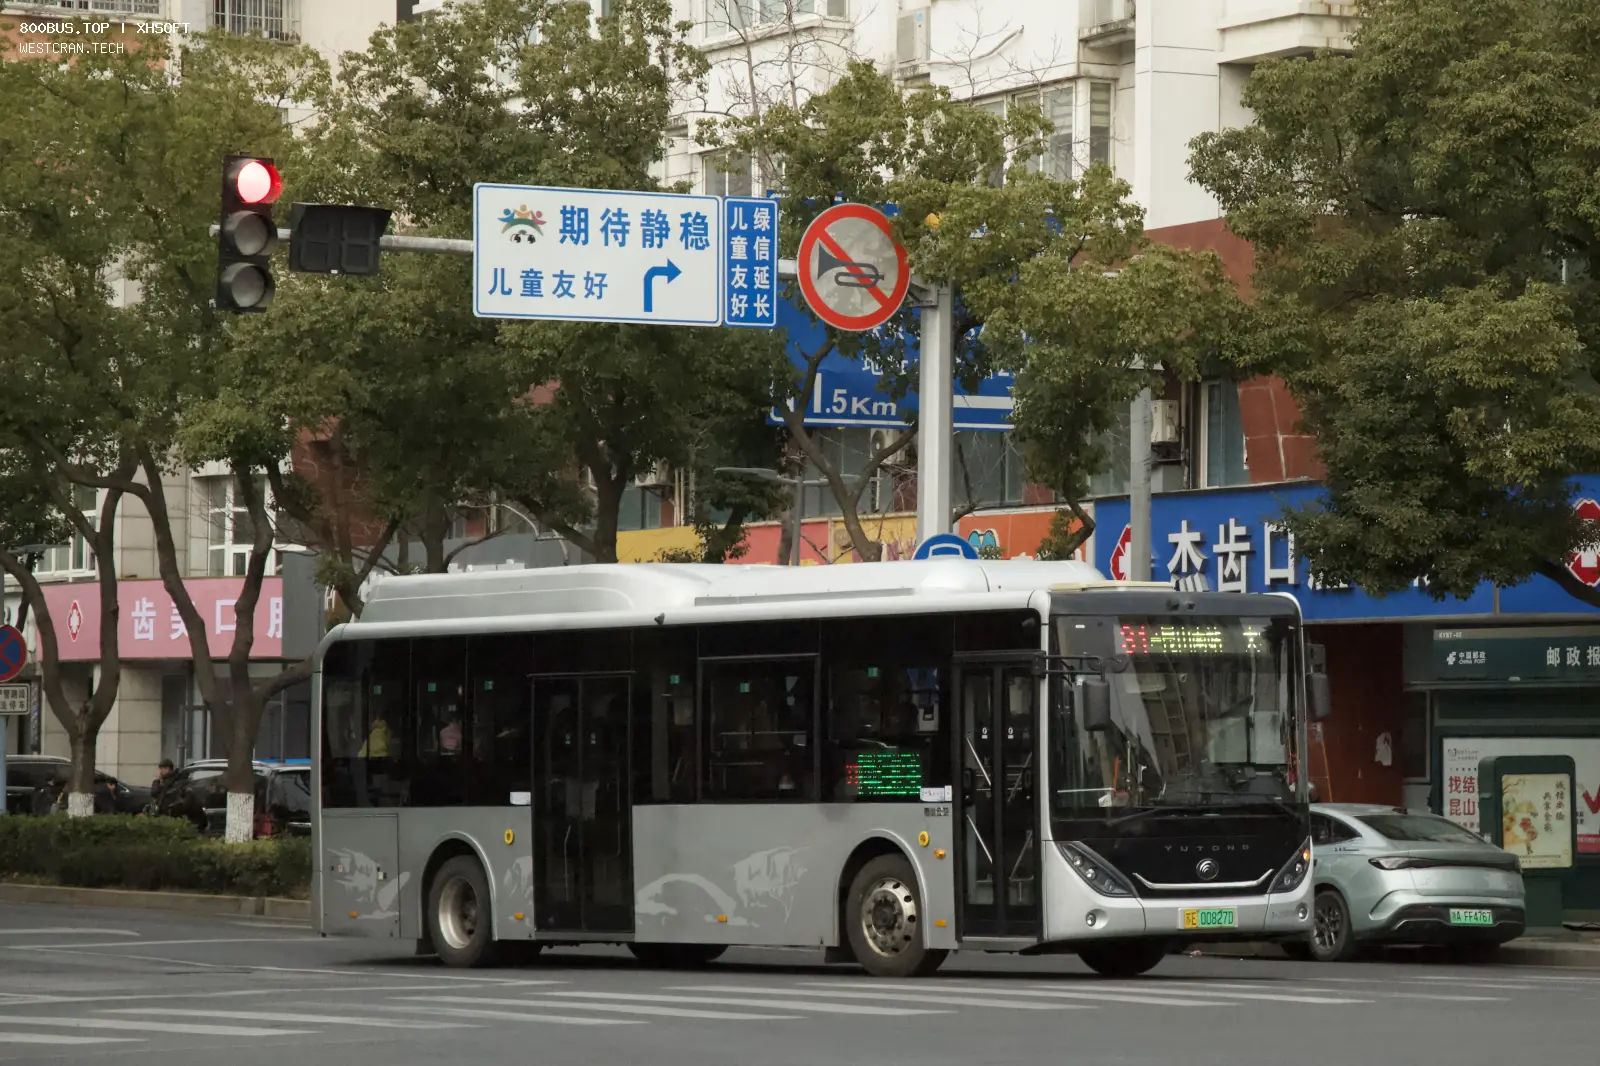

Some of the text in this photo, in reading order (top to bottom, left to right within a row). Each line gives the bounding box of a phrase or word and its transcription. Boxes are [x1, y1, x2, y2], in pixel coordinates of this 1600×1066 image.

[559, 205, 711, 250] 期待静稳
[730, 207, 748, 318] 儿童友好
[752, 207, 771, 318] 绿信延长
[488, 267, 609, 300] 儿童友好
[1448, 776, 1479, 794] 找结
[1449, 798, 1476, 816] 昆山
